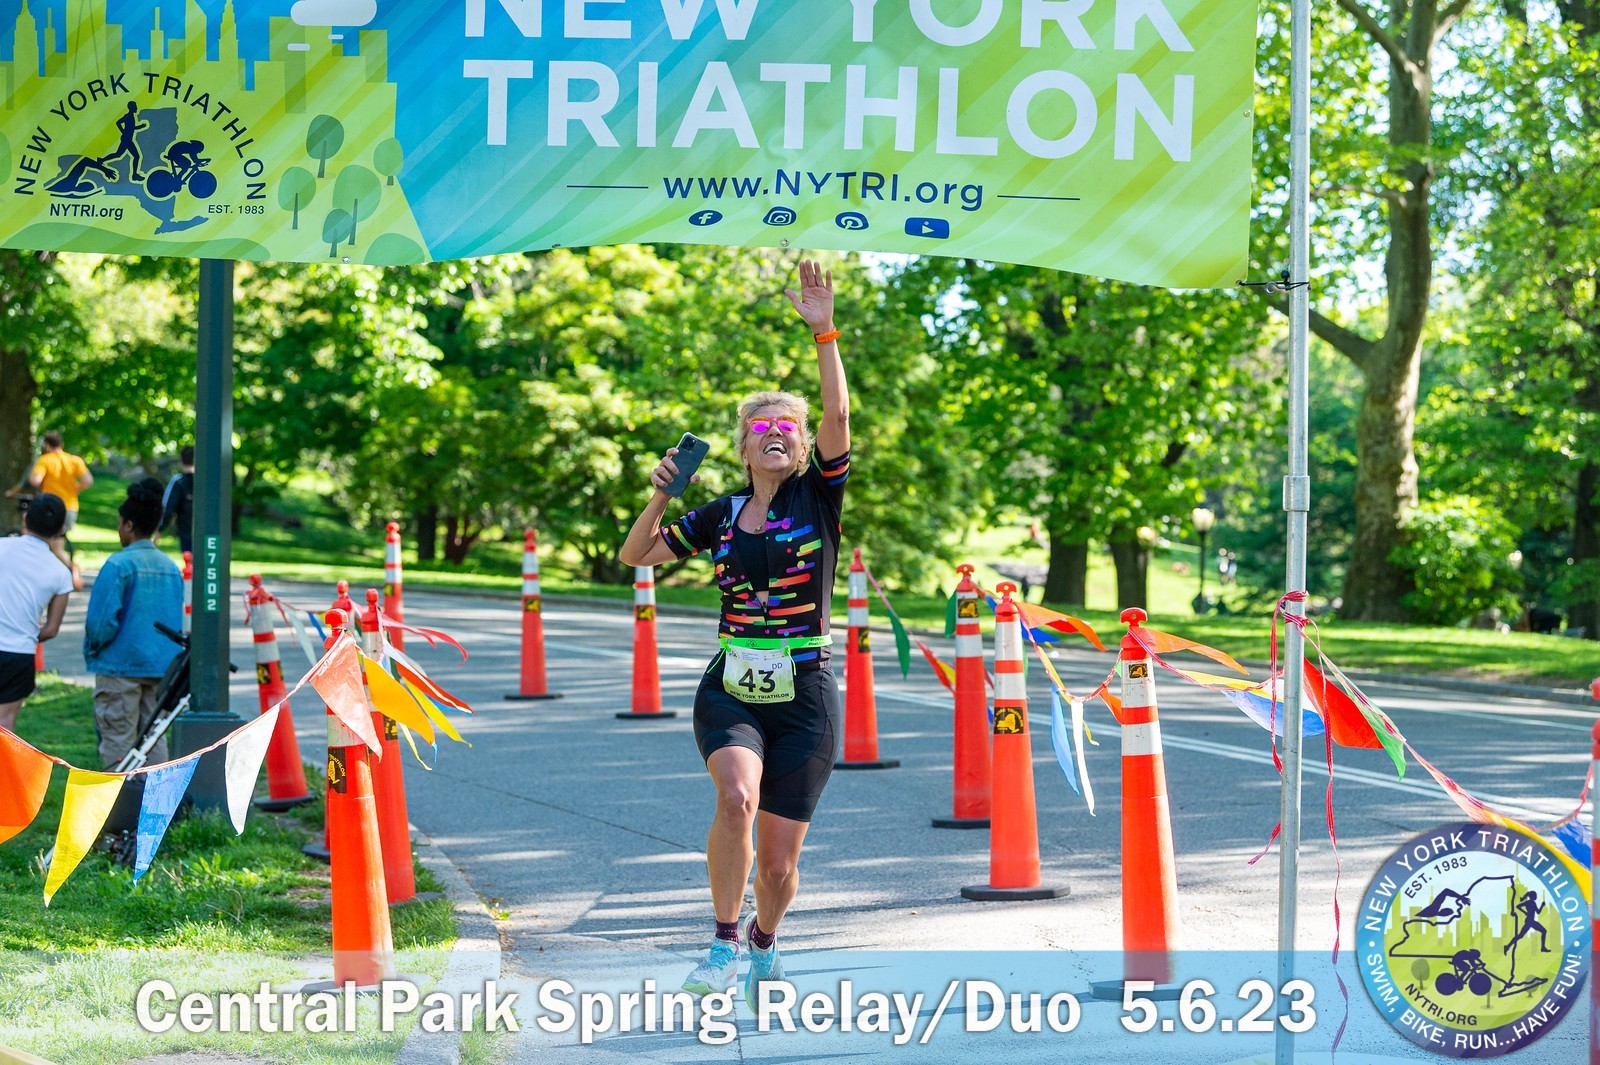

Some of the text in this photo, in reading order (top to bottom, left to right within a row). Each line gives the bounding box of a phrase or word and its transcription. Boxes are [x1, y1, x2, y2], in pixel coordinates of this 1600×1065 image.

[463, 59, 1196, 163] TRIATHLON
[14, 72, 267, 200] NEW YORK TRIATHLON
[662, 168, 984, 212] www.NYTRI.org
[49, 203, 125, 221] NYTRI.org
[207, 204, 266, 216] EST. 1983
[207, 537, 217, 611] E7502
[771, 662, 783, 670] DD
[738, 667, 776, 693] 43
[757, 692, 790, 700] TRIATHLON
